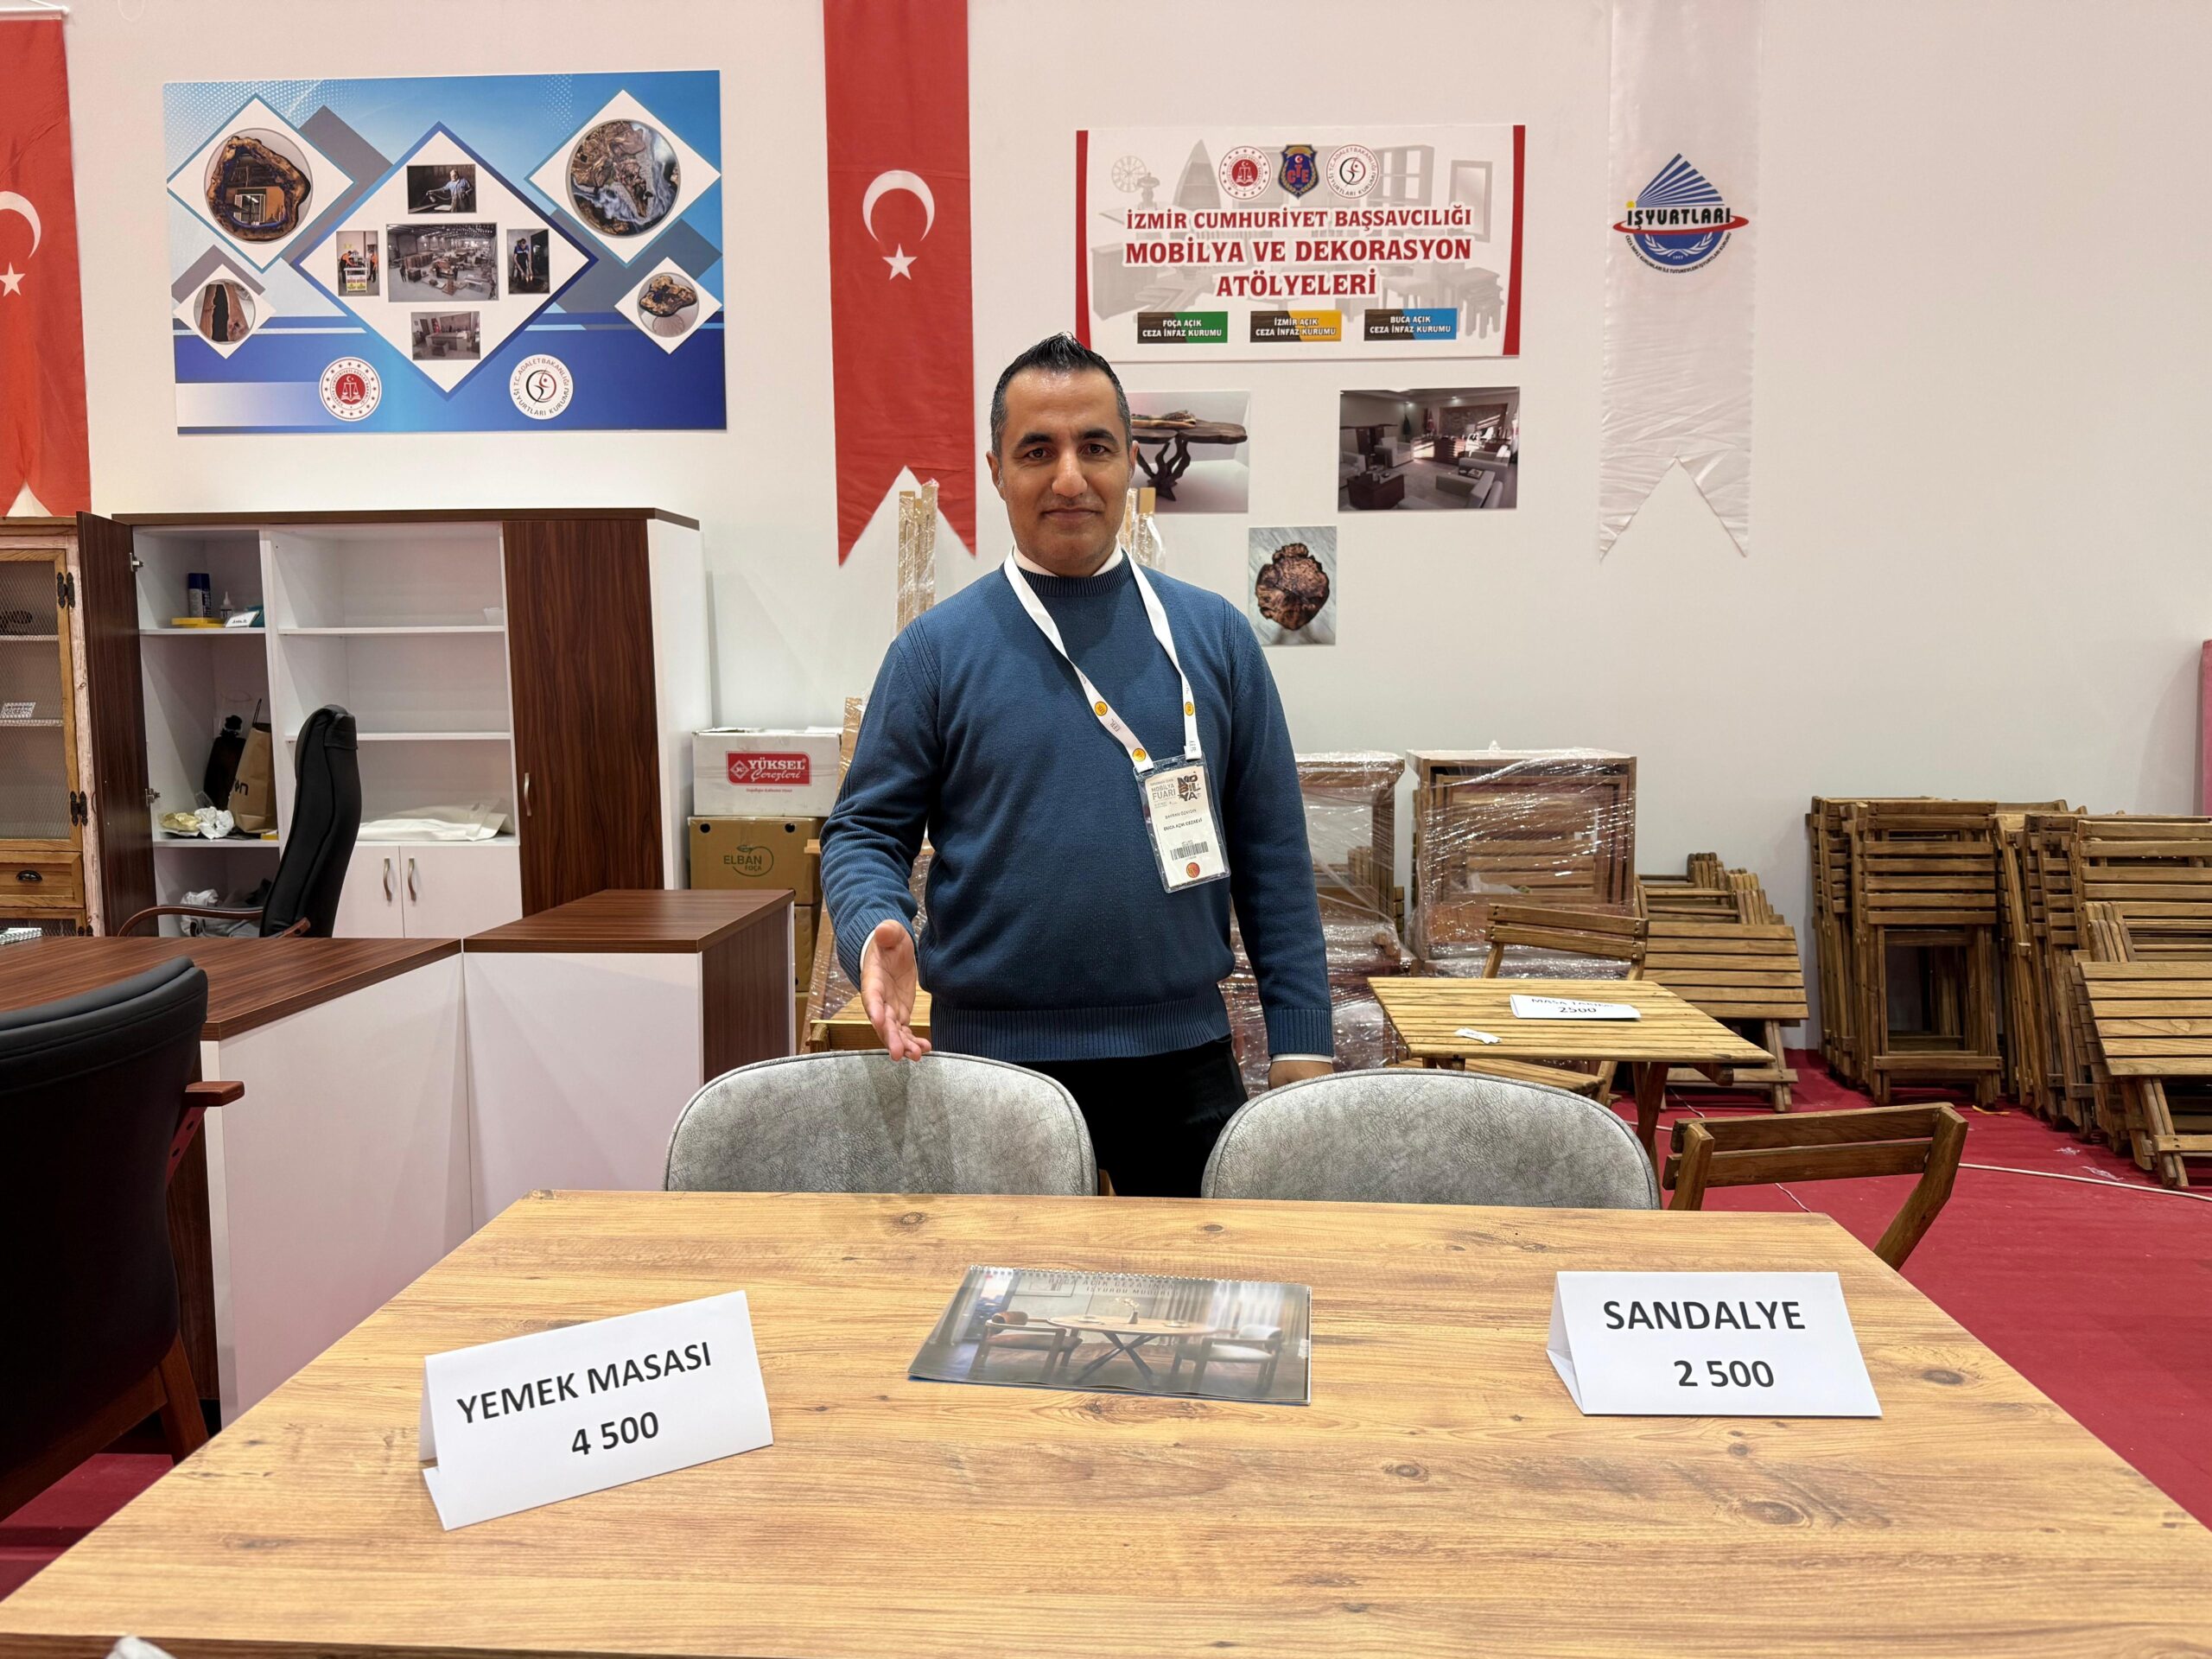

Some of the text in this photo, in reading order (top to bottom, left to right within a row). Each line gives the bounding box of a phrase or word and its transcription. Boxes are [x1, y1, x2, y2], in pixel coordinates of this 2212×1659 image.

[1127, 204, 1471, 232] İZMİR CUMHURİYET BAŞSAVCILIĞI
[1125, 238, 1471, 264] MOBİLYA VE DEKORASYON
[1216, 269, 1377, 297] ATÖLYELERİ
[1163, 320, 1202, 328] FOÇA AÇIK
[1274, 317, 1319, 327] İZMİR AÇIK
[1412, 315, 1431, 325] AÇIK
[1164, 327, 1186, 337] İNFAZ
[1277, 327, 1300, 336] İNFAZ
[1301, 327, 1336, 336] KURUMU
[1391, 324, 1414, 334] İNFAZ
[747, 757, 805, 770] YÜKSEL
[751, 769, 801, 782] Çerezleri
[1152, 788, 1176, 800] FUARI
[723, 855, 762, 865] ELBAN
[1603, 1300, 1806, 1331] SANDALYE
[1674, 1360, 1775, 1389] 2 500
[456, 1341, 712, 1424] YEMEK MASASI
[571, 1411, 659, 1456] 4 500
